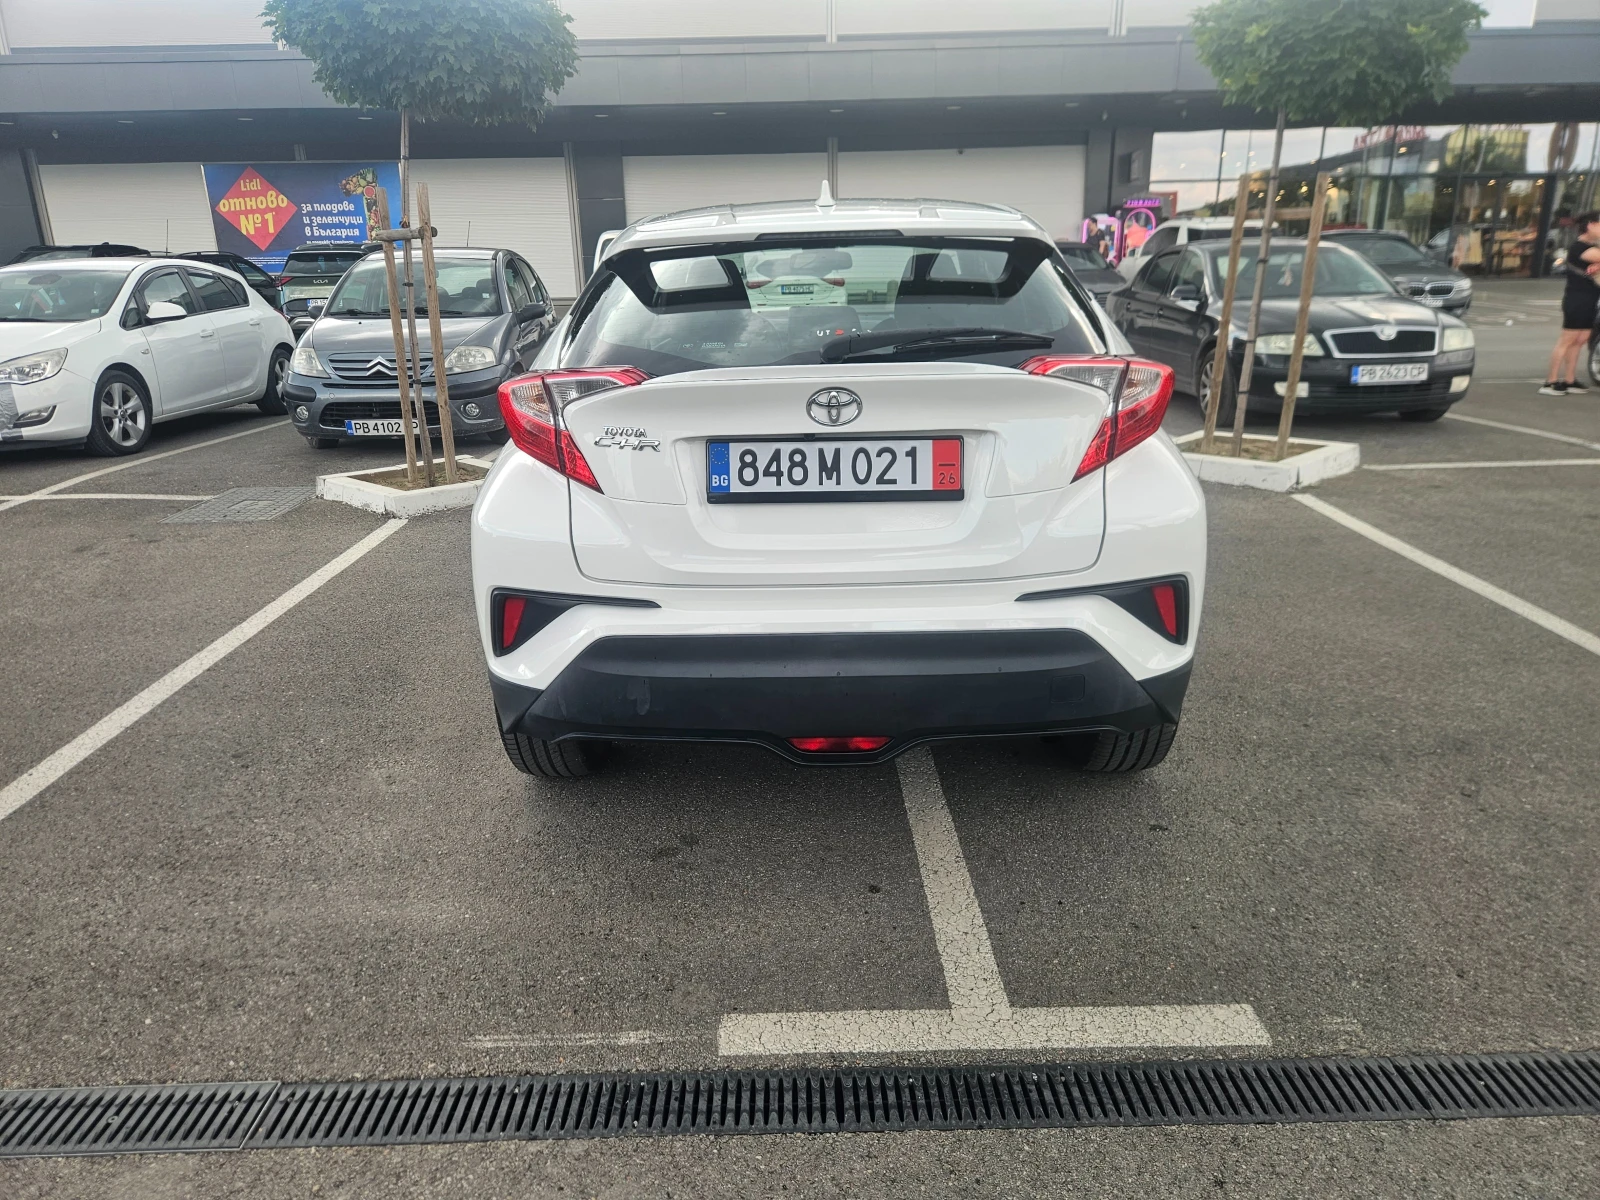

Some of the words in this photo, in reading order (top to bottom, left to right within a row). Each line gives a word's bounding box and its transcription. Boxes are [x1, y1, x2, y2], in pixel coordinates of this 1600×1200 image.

[240, 178, 262, 192] Lidl
[219, 190, 288, 213] отново
[301, 203, 312, 214] за
[314, 201, 355, 215] плодове
[303, 215, 310, 224] и
[312, 215, 364, 227] зеленчуци
[305, 227, 312, 236] в
[313, 226, 360, 239] България
[1361, 367, 1376, 380] PB
[1411, 365, 1425, 378] CP
[354, 422, 370, 433] PB
[373, 422, 401, 433] 4102
[603, 426, 647, 438] TOYOTA
[594, 436, 661, 452] C-HR
[711, 475, 729, 487] BG
[737, 448, 809, 487] 848
[818, 447, 841, 486] M
[851, 446, 918, 485] 021
[938, 472, 956, 485] 26
